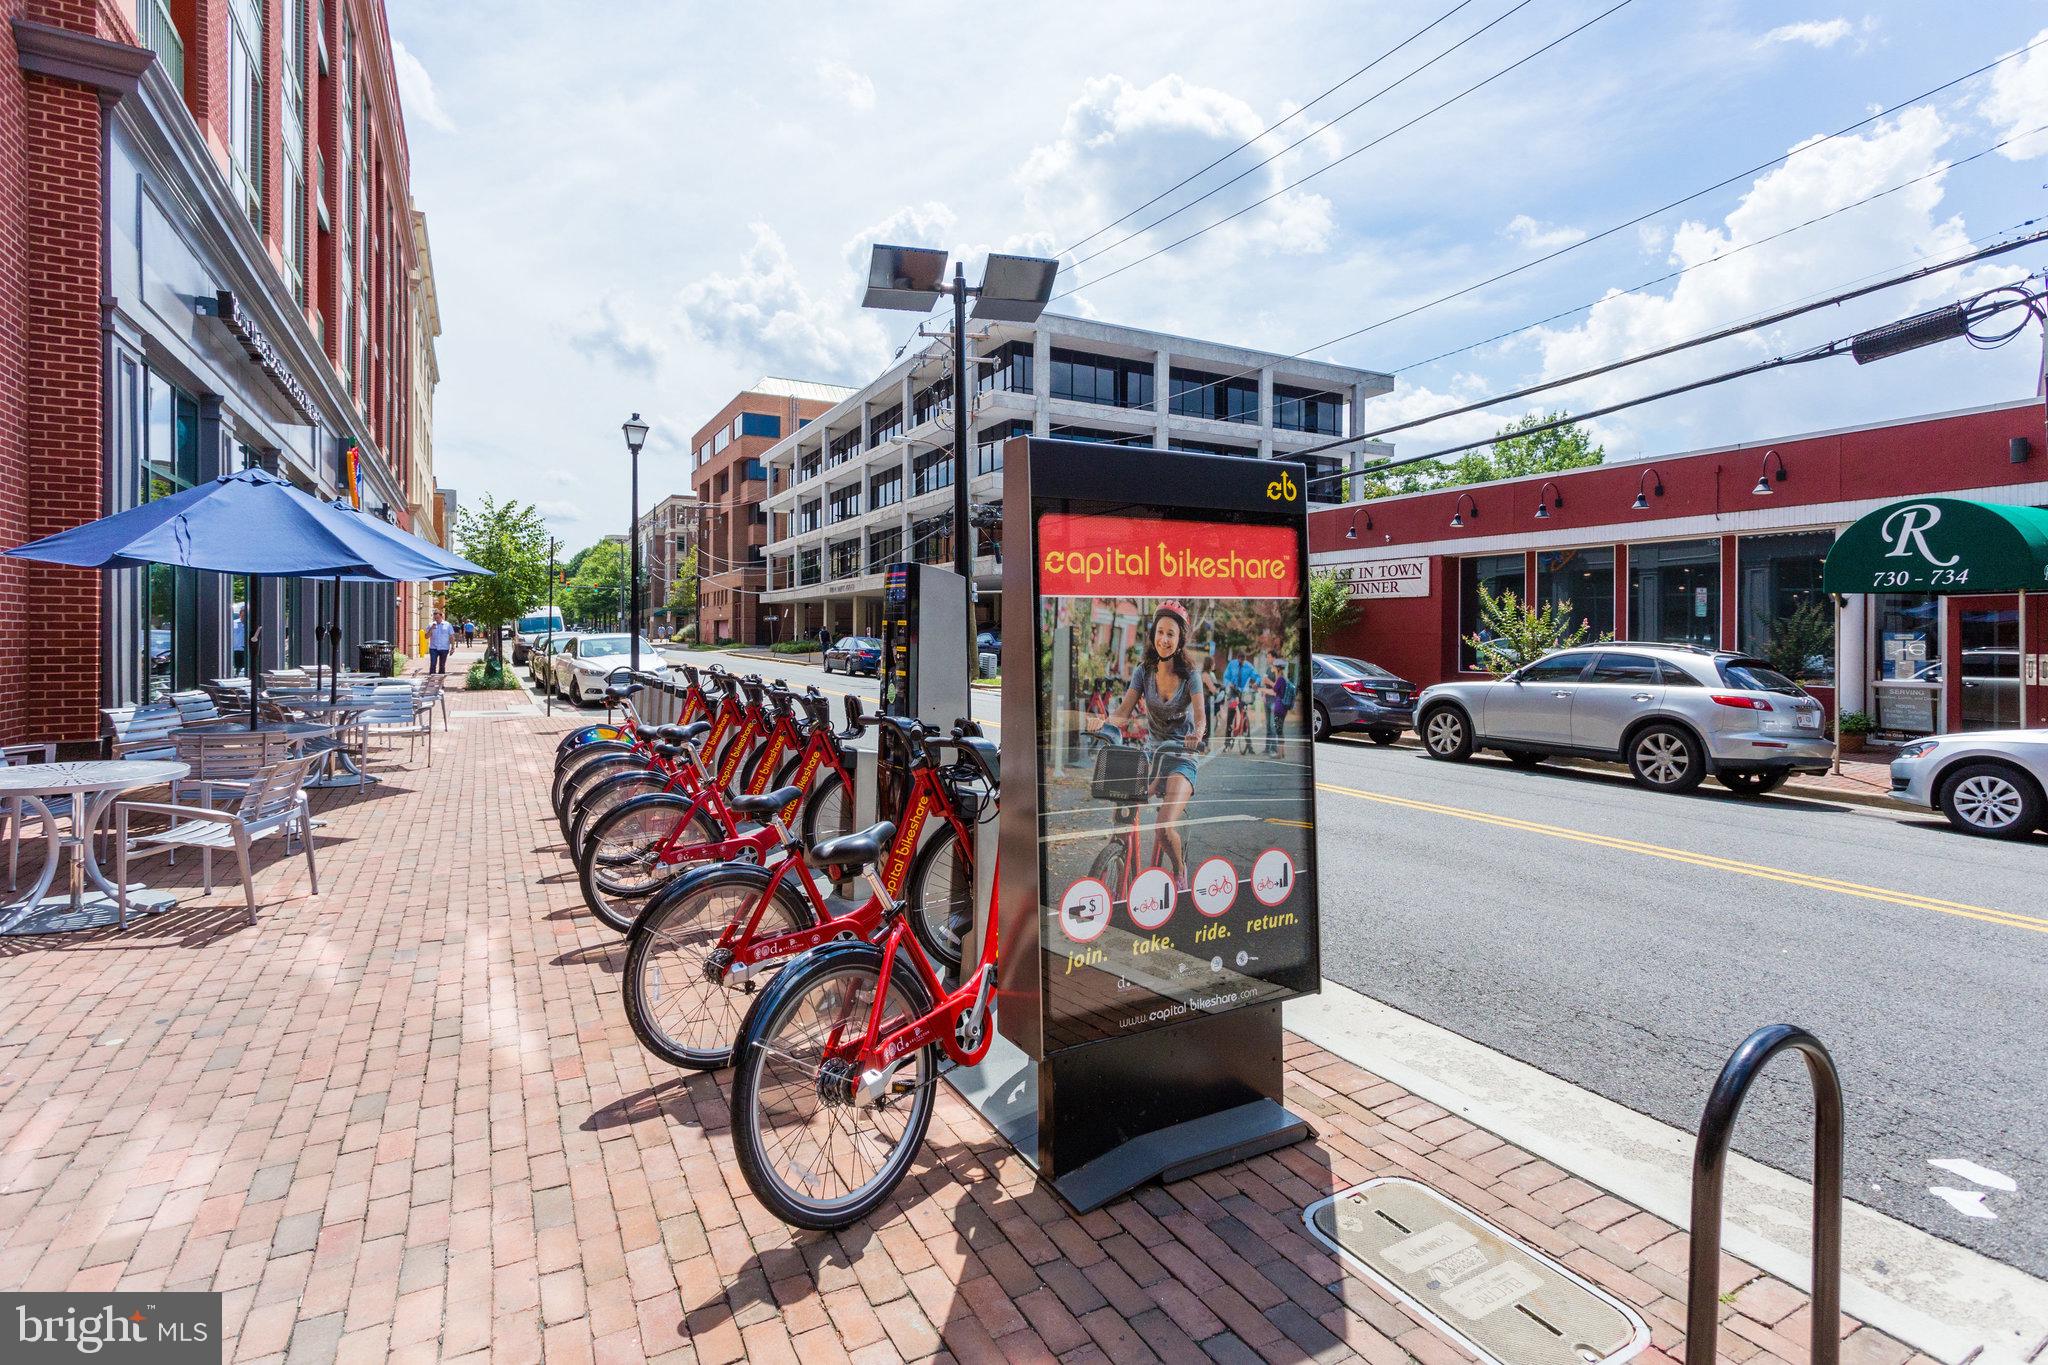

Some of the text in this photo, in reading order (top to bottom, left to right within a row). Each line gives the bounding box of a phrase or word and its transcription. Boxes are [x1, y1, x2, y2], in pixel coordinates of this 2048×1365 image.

[1881, 504, 1960, 567] R
[1044, 546, 1149, 583] capital
[1158, 541, 1285, 580] bikeshare
[1359, 566, 1374, 579] IN
[1379, 563, 1423, 578] TOWN
[1873, 571, 1909, 587] 730
[1930, 568, 1969, 585] 734
[1348, 581, 1400, 595] DINNER
[1889, 688, 1925, 696] SERVING
[733, 722, 753, 757] bikeshare
[762, 734, 785, 774] bikeshare
[796, 751, 821, 791] ikeshare
[888, 796, 929, 899] apital bikeshare
[1065, 912, 1298, 975] join. take. ride. return.
